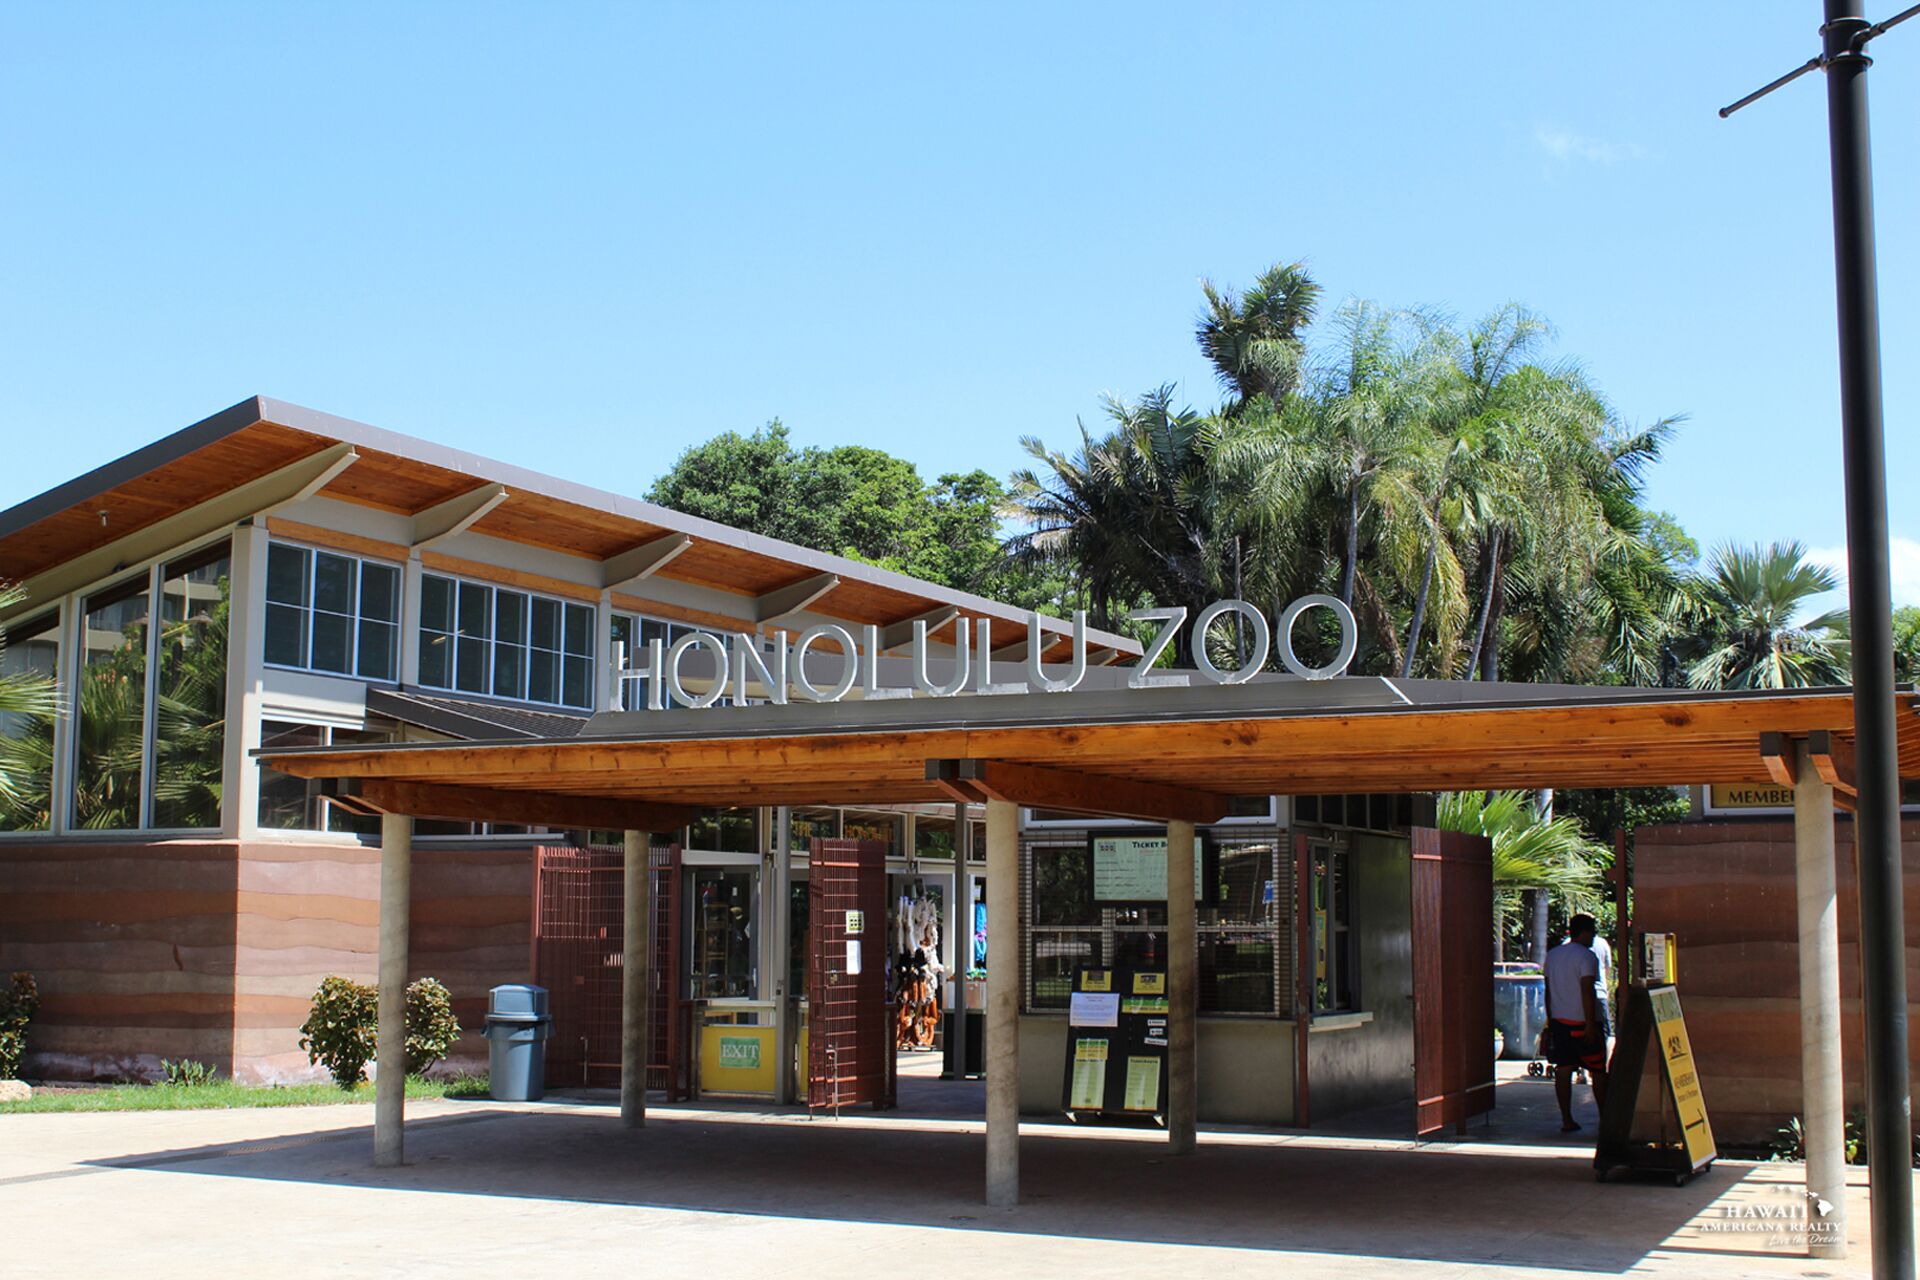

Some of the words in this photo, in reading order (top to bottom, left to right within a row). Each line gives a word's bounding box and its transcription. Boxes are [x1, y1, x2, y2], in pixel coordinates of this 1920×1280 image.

[610, 610, 1087, 711] HONOLULU
[1127, 594, 1359, 689] ZOO
[1728, 790, 1795, 804] MEMBE
[722, 1044, 759, 1059] EXIT
